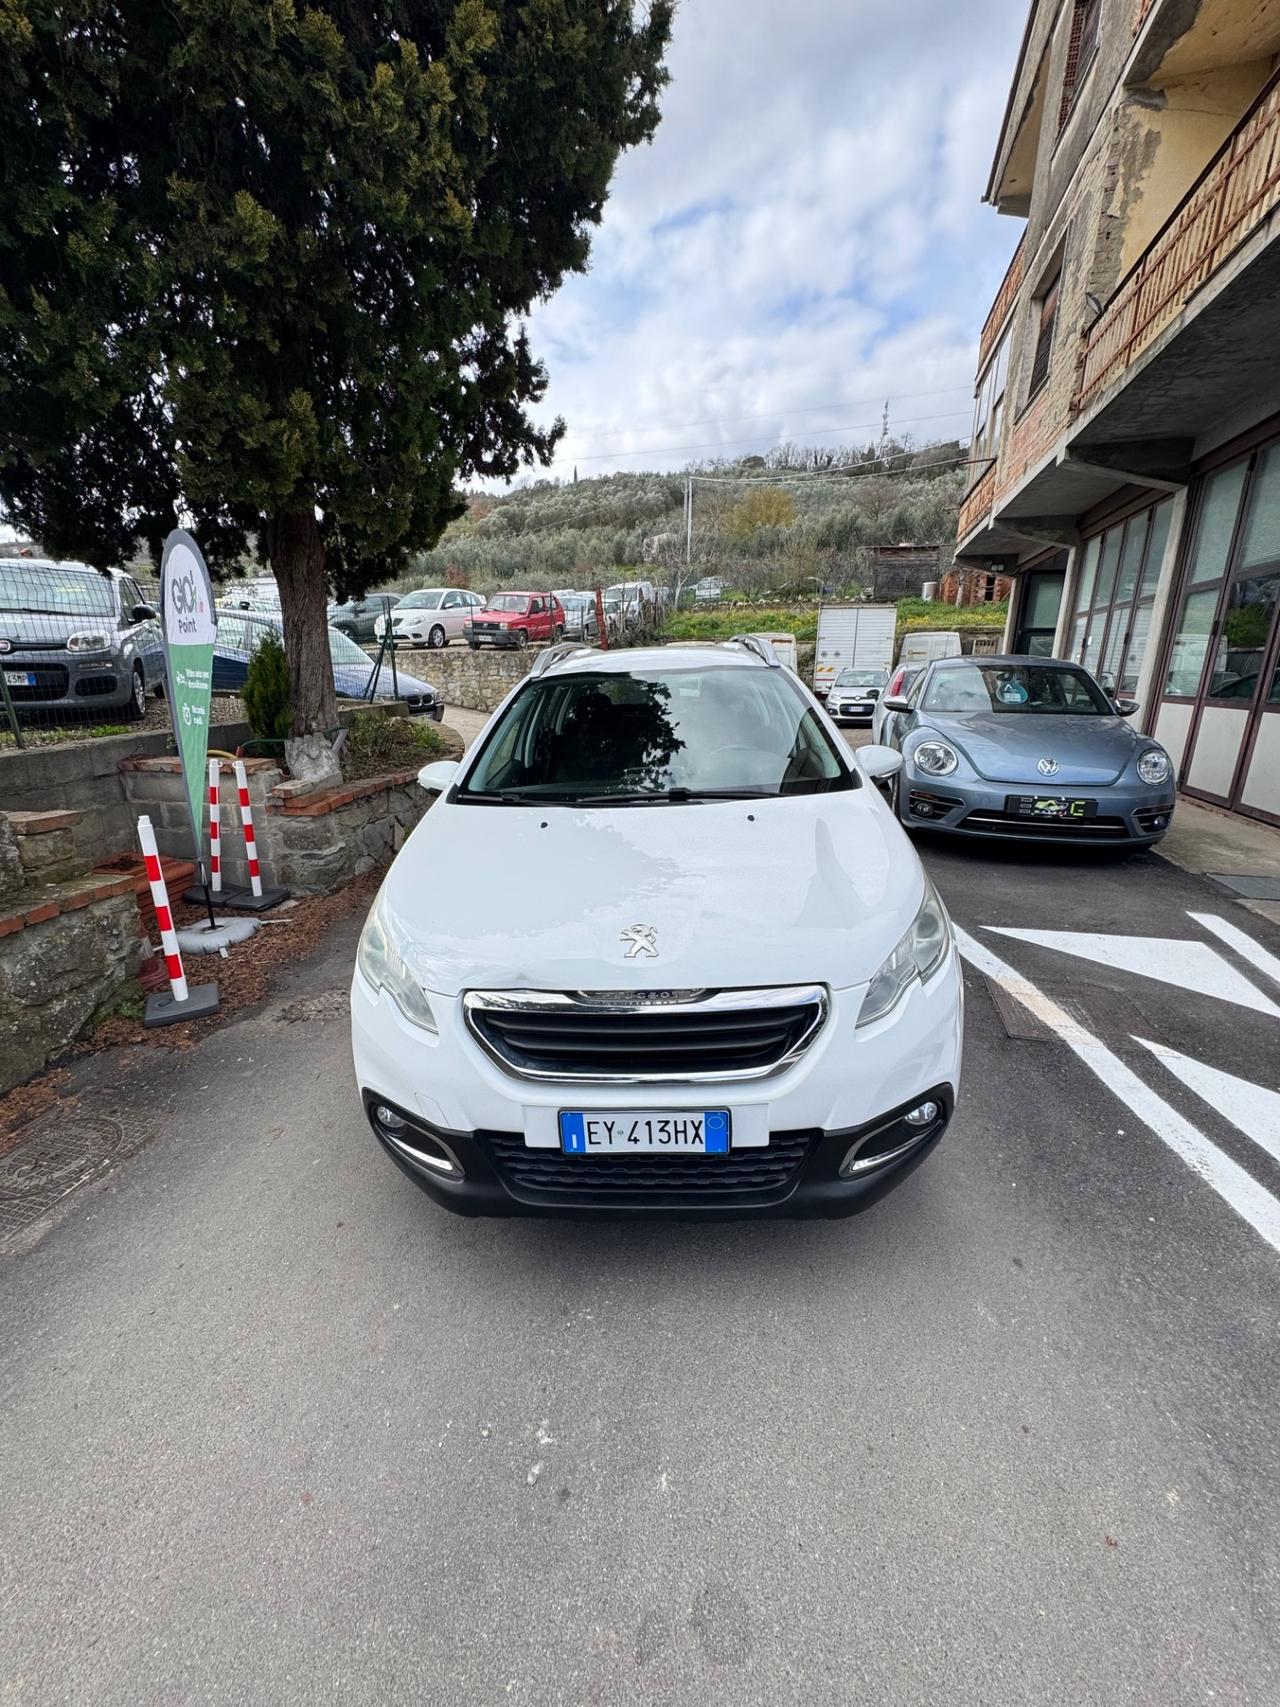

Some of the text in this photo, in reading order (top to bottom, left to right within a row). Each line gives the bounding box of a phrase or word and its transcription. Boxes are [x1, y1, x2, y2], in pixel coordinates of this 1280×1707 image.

[178, 617, 197, 634] Point
[587, 1121, 616, 1145] EY
[627, 1120, 704, 1145] 413HX
